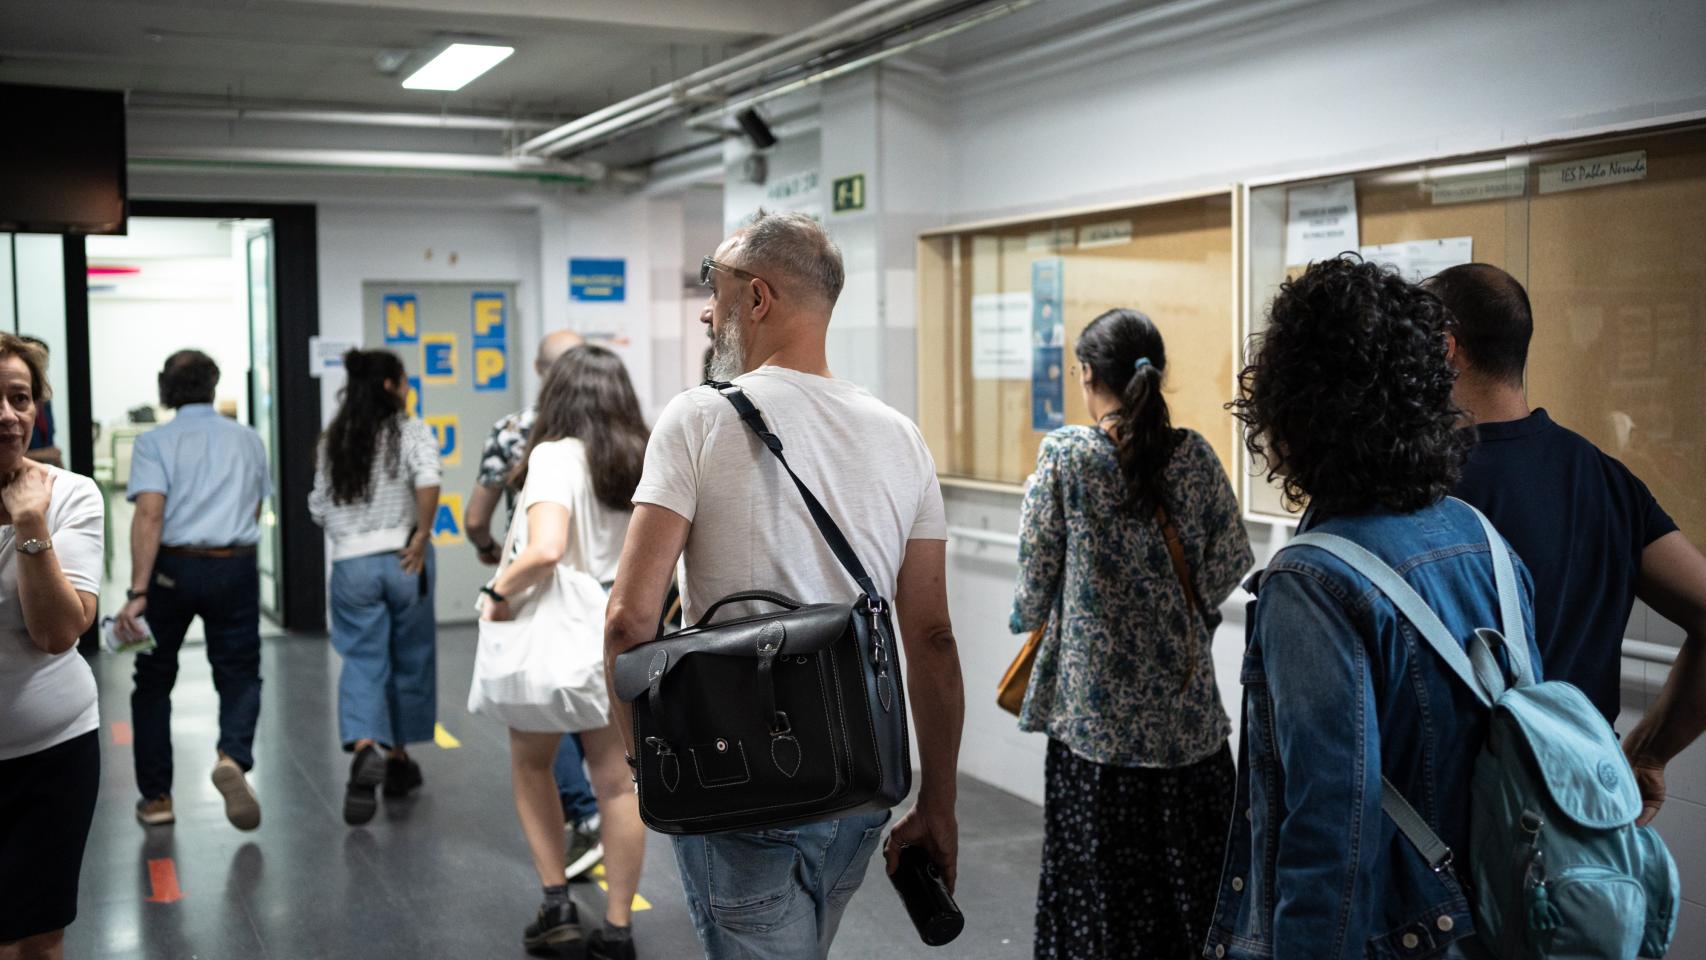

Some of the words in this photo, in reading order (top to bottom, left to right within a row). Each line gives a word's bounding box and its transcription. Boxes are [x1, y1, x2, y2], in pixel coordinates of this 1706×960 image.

[1561, 167, 1577, 184] IES
[1579, 163, 1606, 181] Pablo
[1609, 160, 1646, 177] Neruda
[386, 301, 416, 337] N
[425, 343, 453, 375] E
